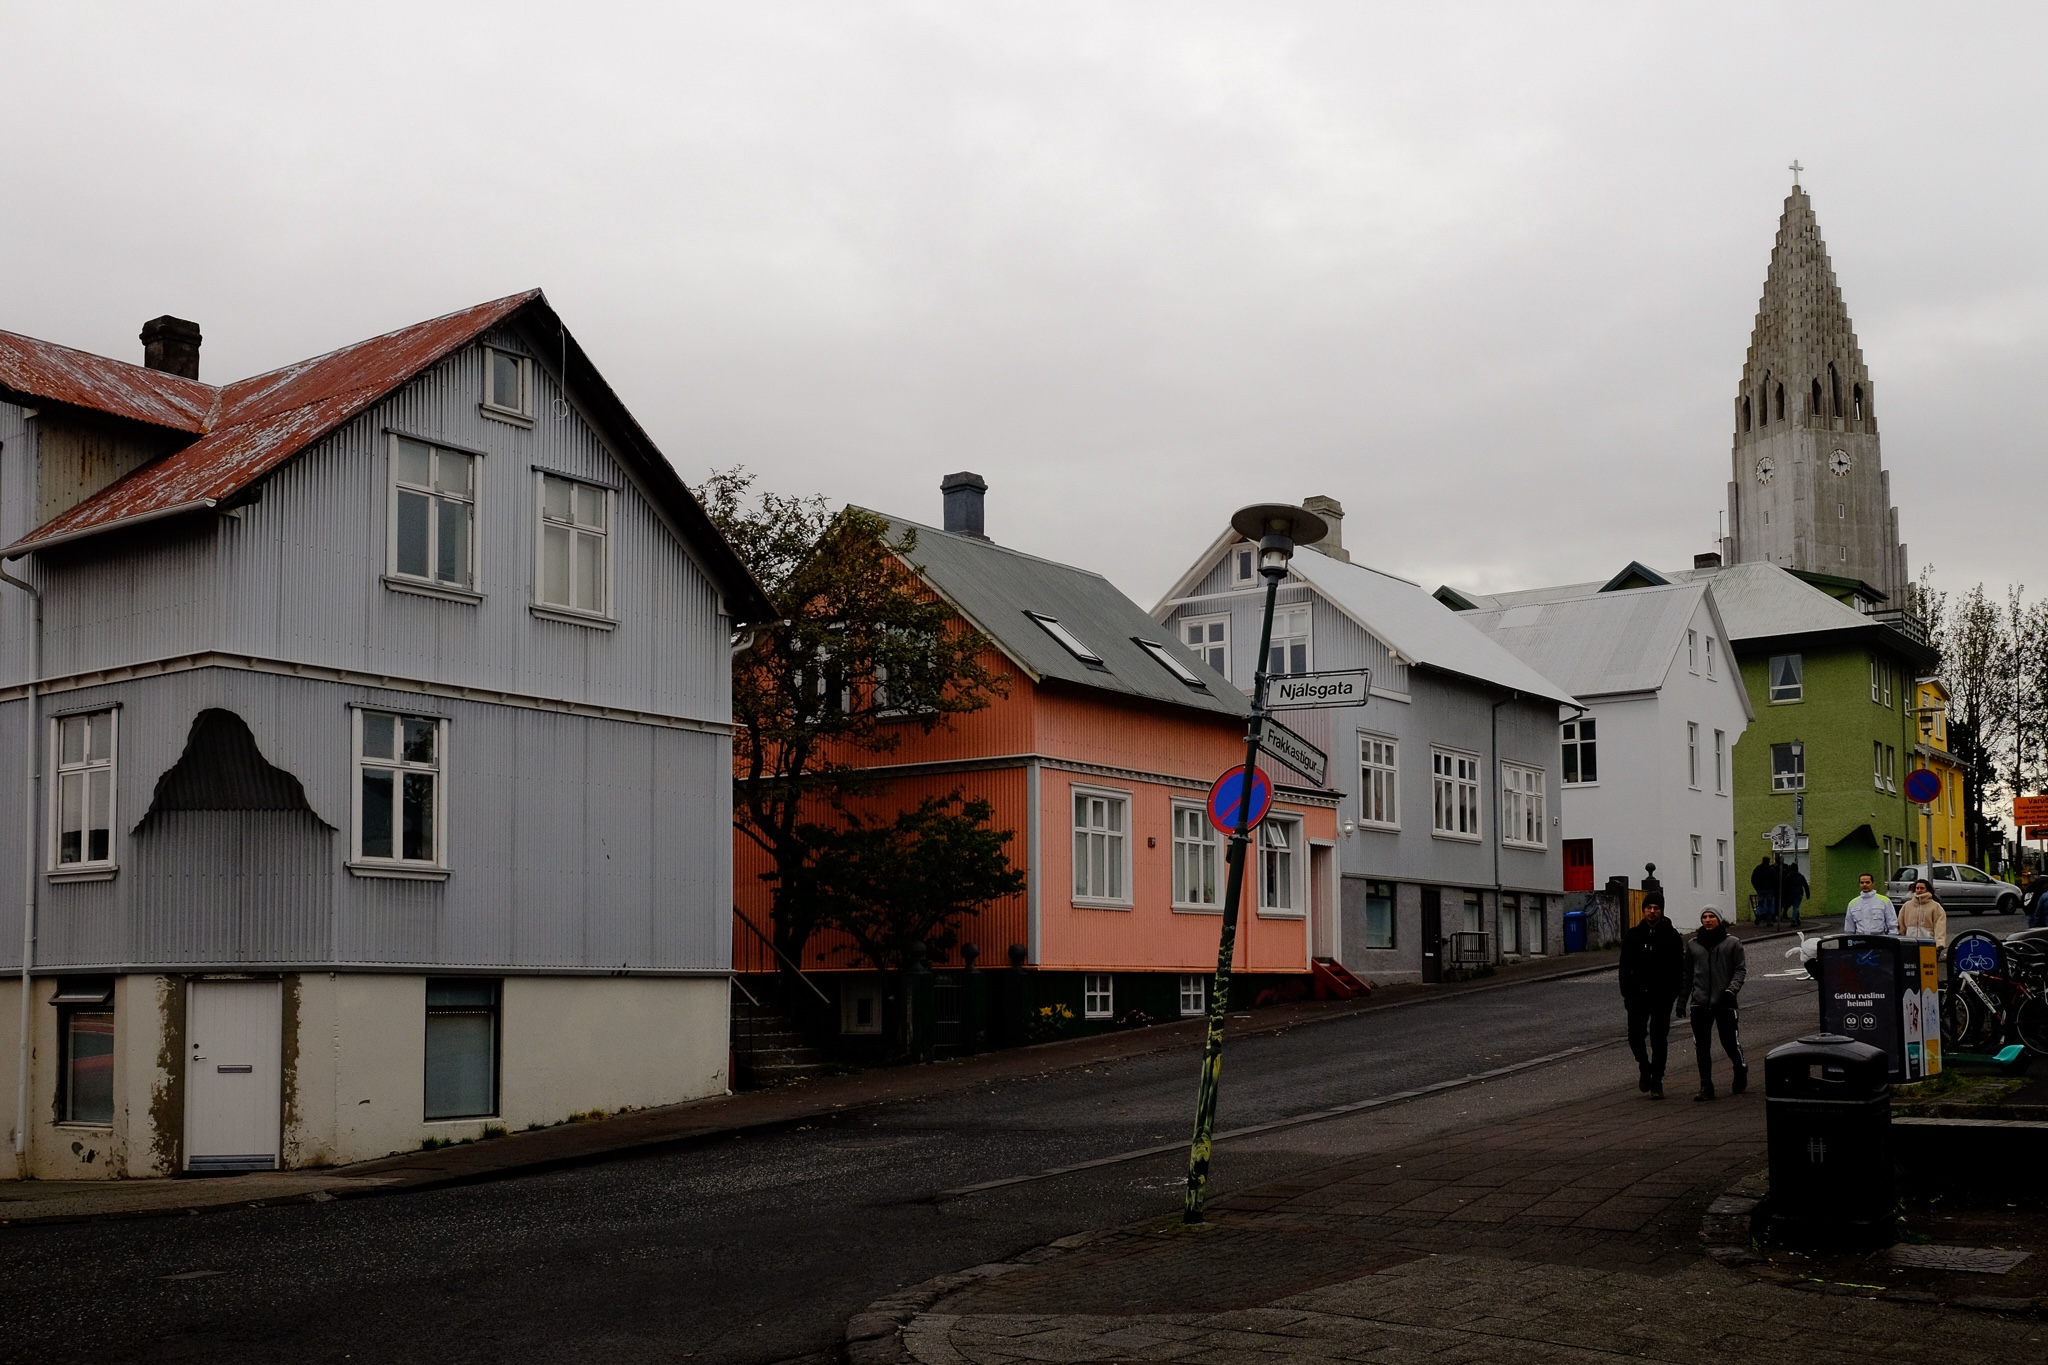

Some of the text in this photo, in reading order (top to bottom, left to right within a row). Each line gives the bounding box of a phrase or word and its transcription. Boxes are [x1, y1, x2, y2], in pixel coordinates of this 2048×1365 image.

[1280, 681, 1353, 700] Njálsgata
[1267, 728, 1318, 770] Frakkastígur
[1970, 939, 1980, 953] P
[1834, 992, 1857, 1000] Gefðu
[1847, 999, 1873, 1007] heimili
